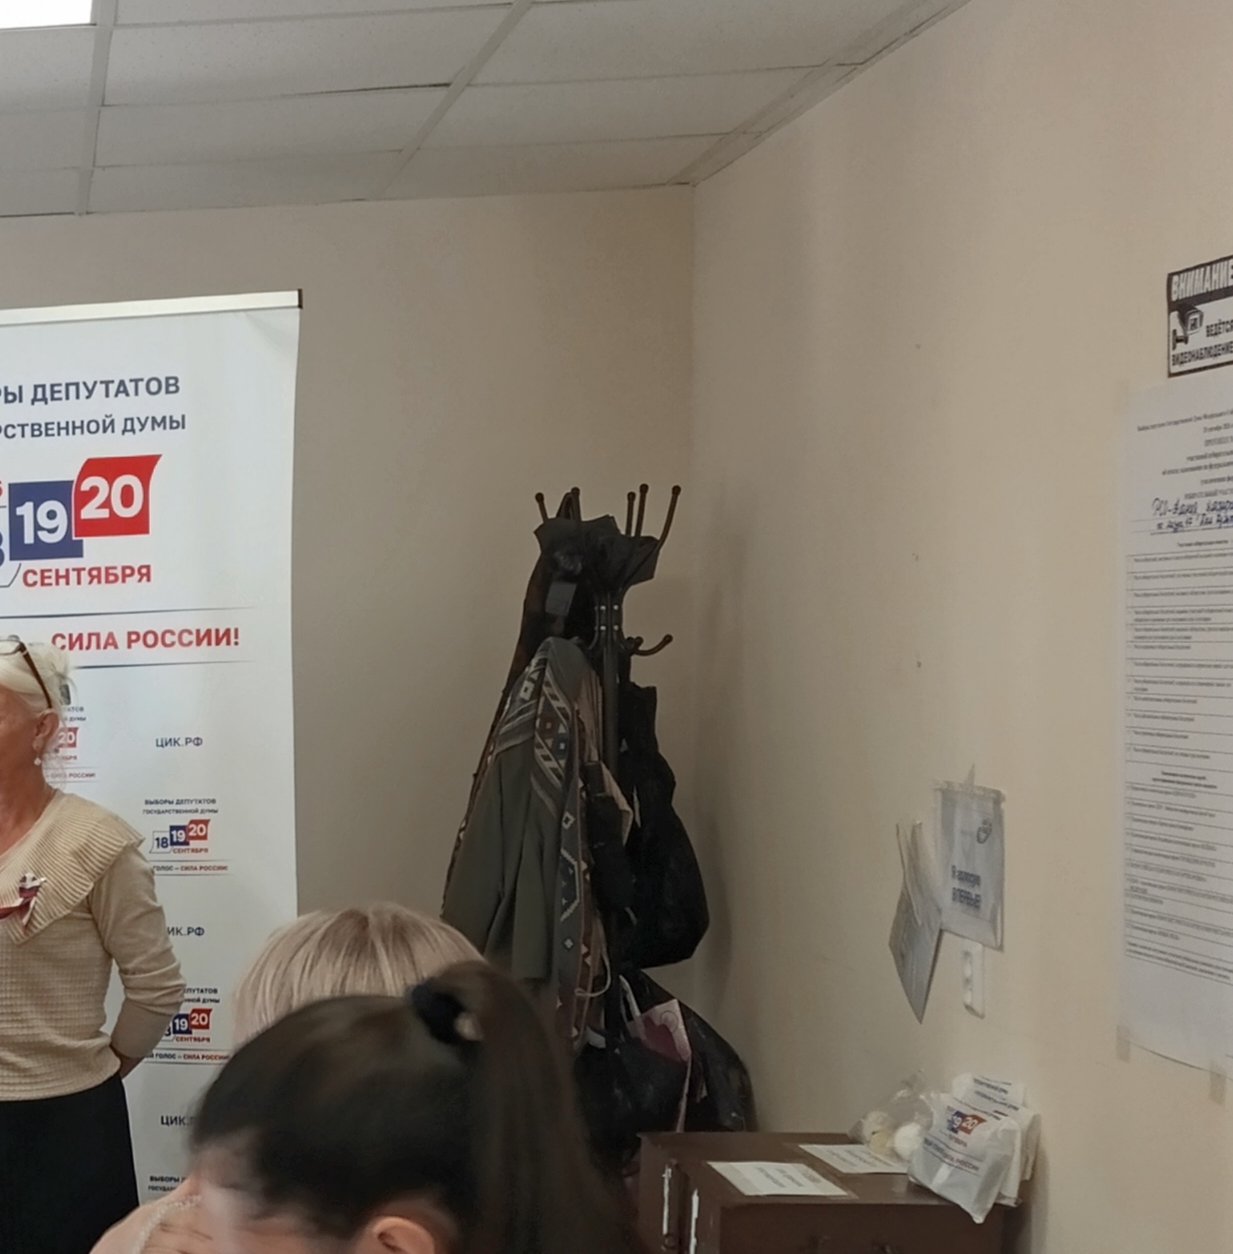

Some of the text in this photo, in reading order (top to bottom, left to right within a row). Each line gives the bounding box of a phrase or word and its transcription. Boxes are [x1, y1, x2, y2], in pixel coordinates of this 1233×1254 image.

[31, 376, 181, 406] ДЕПУТАТОВ
[122, 414, 186, 436] ДУМЫ
[15, 500, 68, 544] 19
[80, 475, 143, 519] 20
[23, 565, 152, 588] СЕНТЯБРЯ
[52, 632, 119, 652] СИЛА
[127, 627, 240, 650] РОССИИ!
[155, 737, 203, 748] ЦИК.РФ
[175, 798, 217, 806] ДЕПУТАТОВ
[155, 824, 207, 849] 18 19 20
[167, 927, 205, 937] ИК.РФ
[174, 1018, 188, 1031] 19
[191, 1013, 209, 1025] 20
[161, 1115, 192, 1127] ЦИК.
[964, 1117, 978, 1129] 20
[149, 1175, 180, 1183] ВЫБОРЫ
